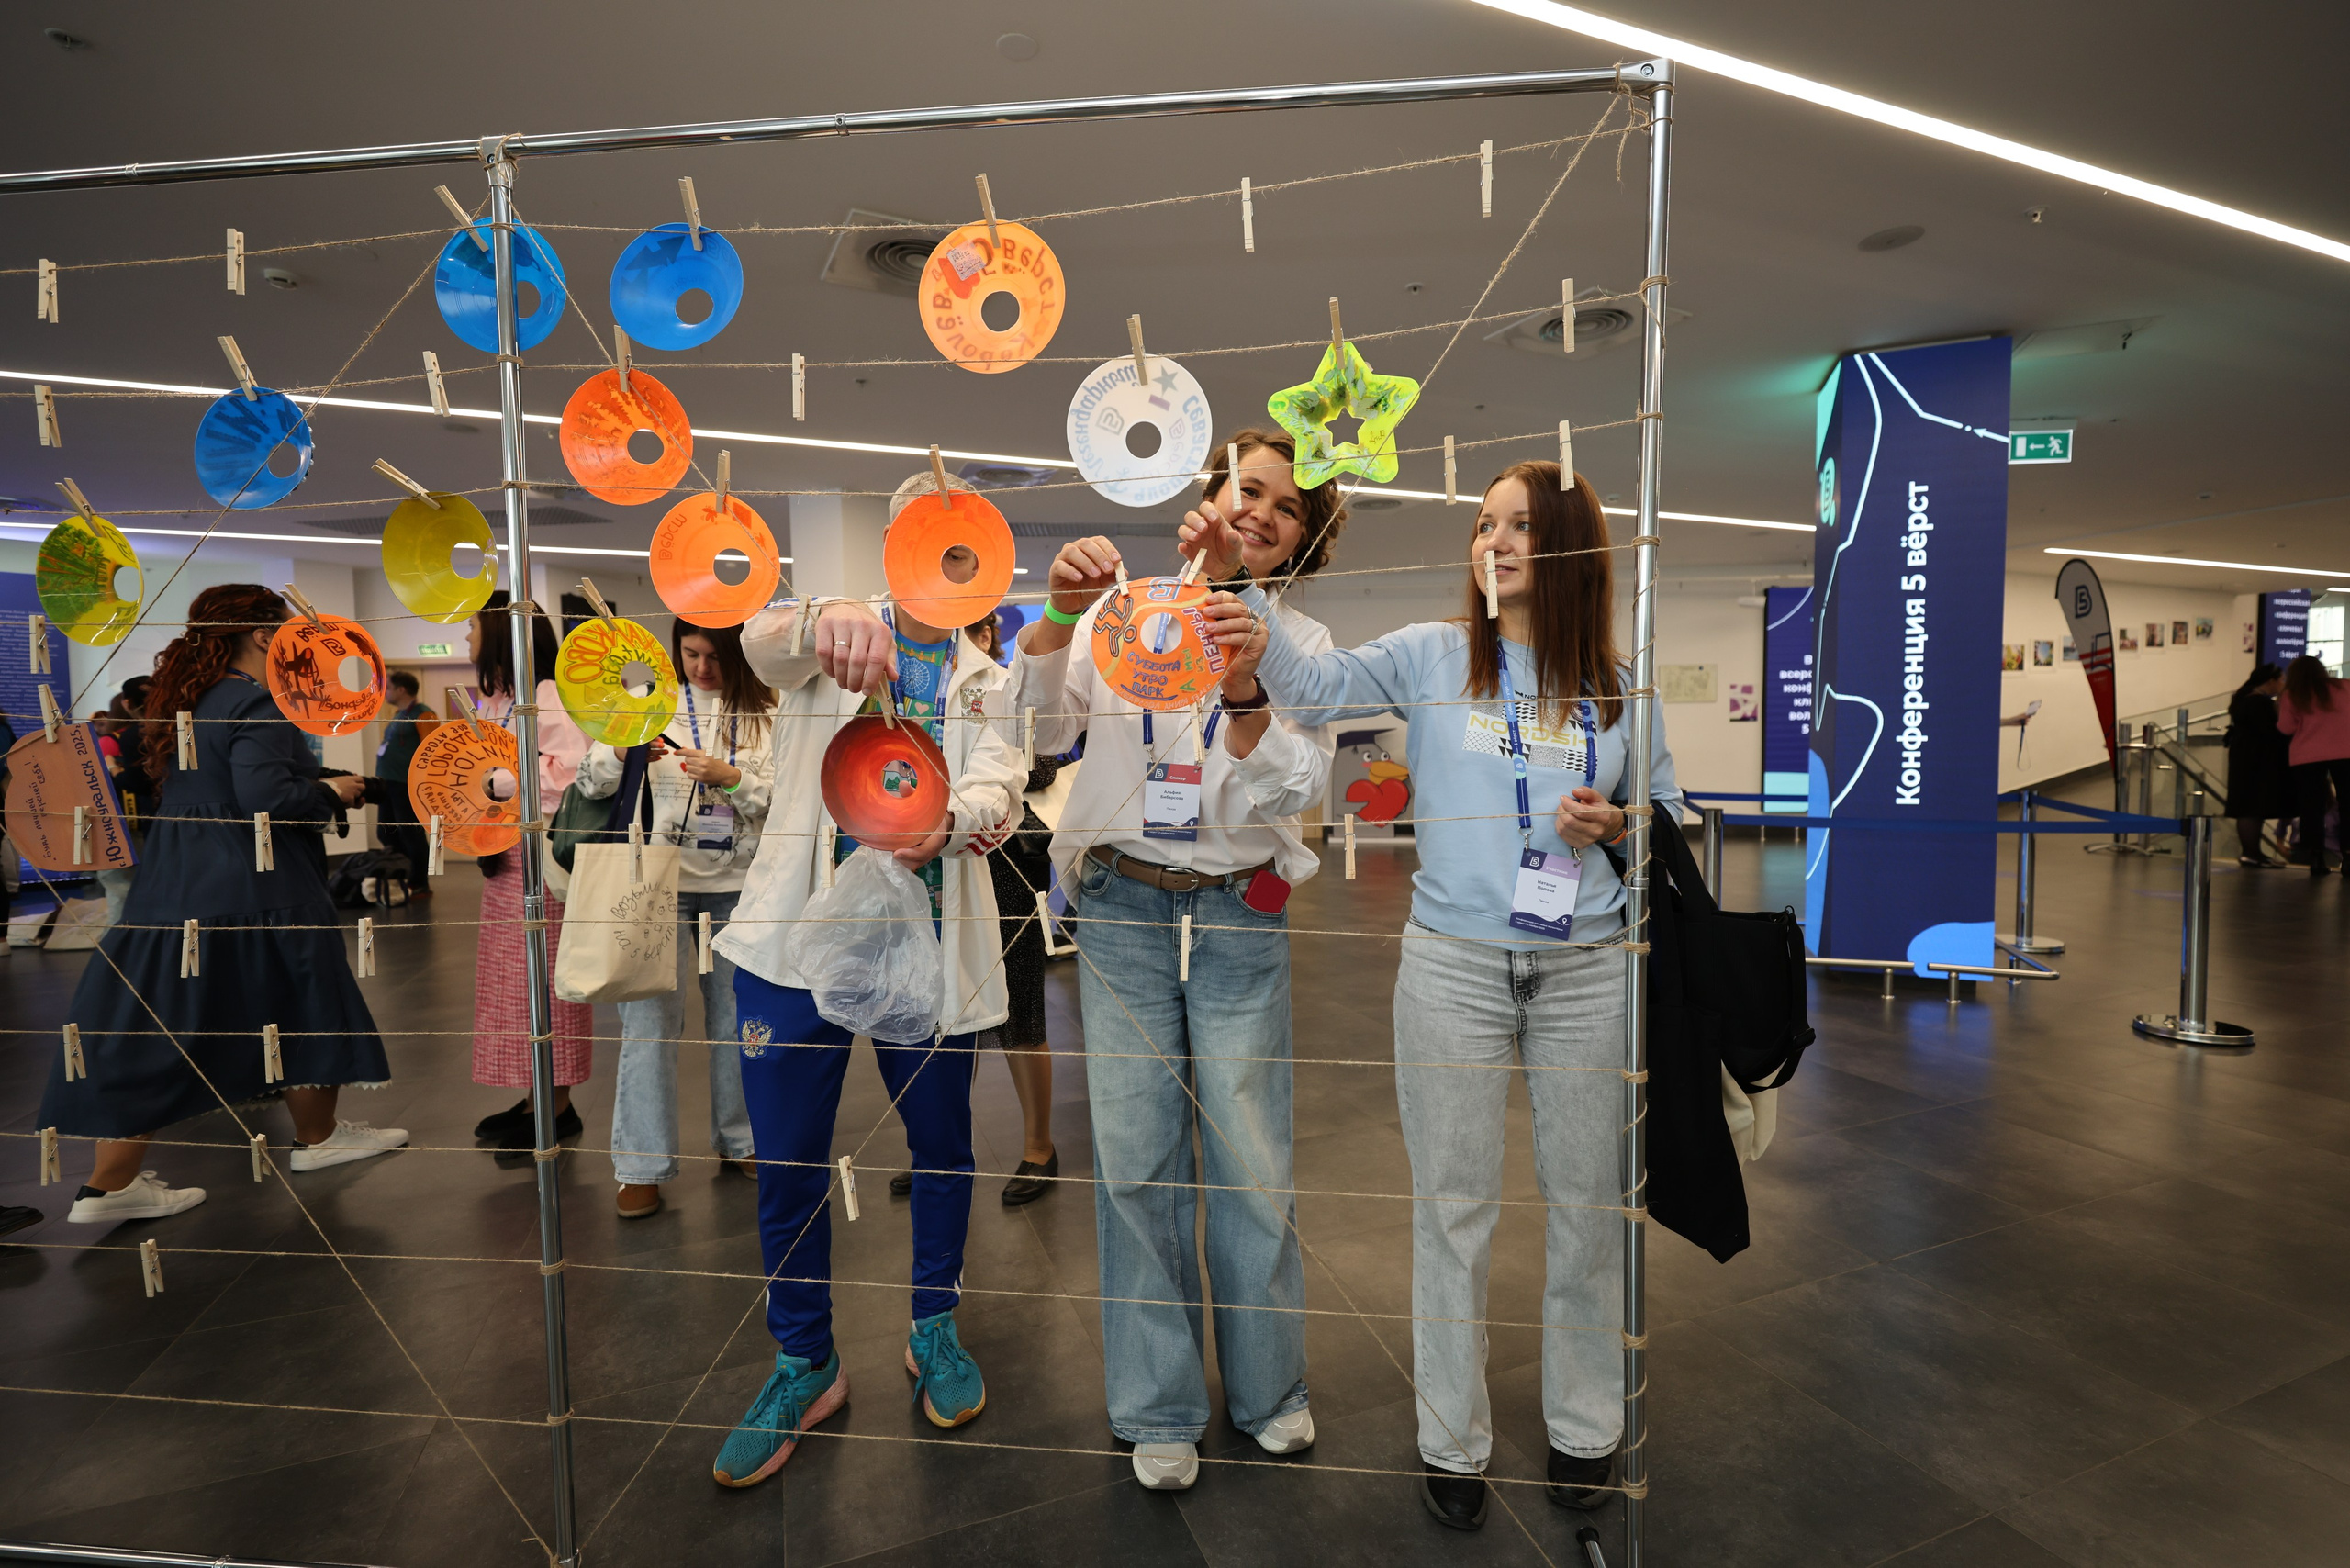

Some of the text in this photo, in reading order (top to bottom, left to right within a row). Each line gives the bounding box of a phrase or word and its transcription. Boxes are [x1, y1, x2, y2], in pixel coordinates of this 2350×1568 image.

[1896, 481, 1934, 805] Конференция 5 вёрст
[1126, 652, 1181, 672] СУББОТА
[1132, 668, 1169, 686] УТРО
[1179, 678, 1196, 691] А
[1132, 681, 1165, 699] ПАРК
